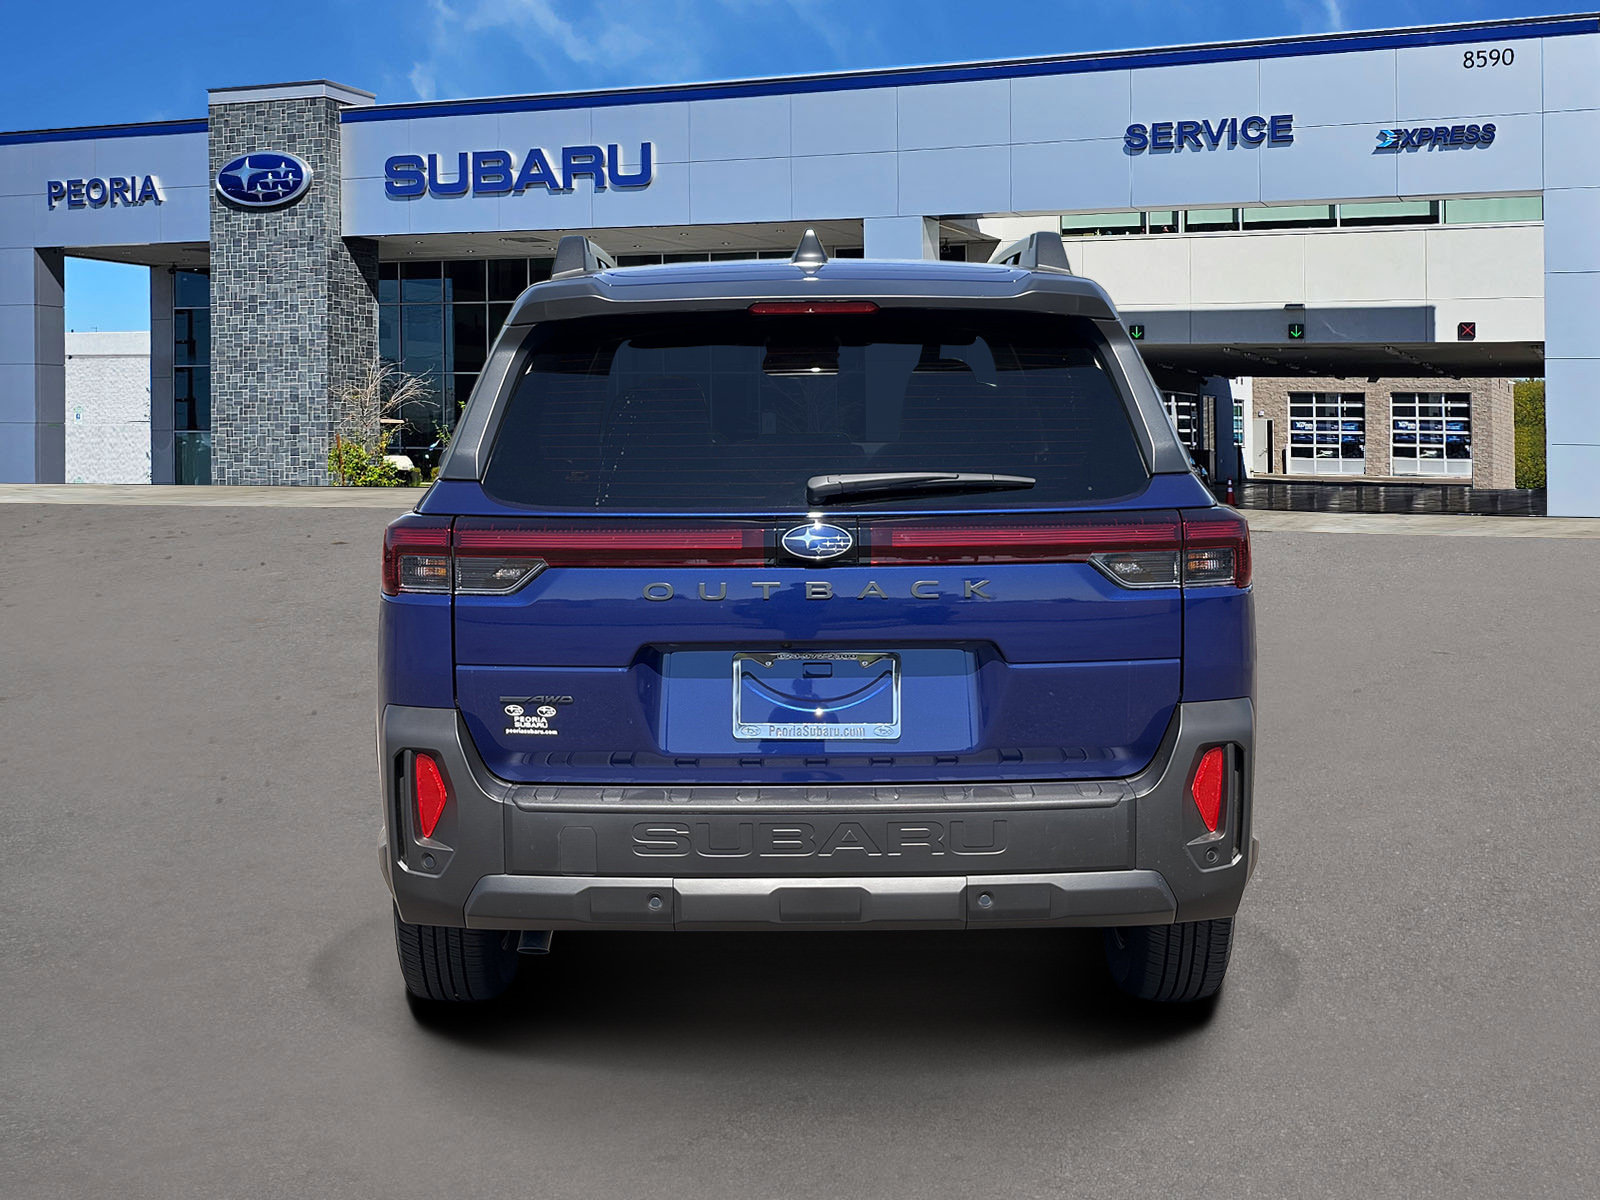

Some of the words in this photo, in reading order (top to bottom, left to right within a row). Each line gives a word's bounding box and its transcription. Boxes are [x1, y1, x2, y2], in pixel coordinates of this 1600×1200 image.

[1463, 48, 1514, 68] 8590
[1125, 114, 1294, 151] SERVICE
[1376, 123, 1496, 148] EXPRESS
[385, 142, 652, 199] SUBARU
[47, 175, 163, 211] PEORIA
[642, 579, 992, 602] OUTBACK
[528, 695, 574, 704] AWD
[768, 725, 866, 738] PeoriaSubaru.com
[631, 819, 1008, 858] SUBARU
